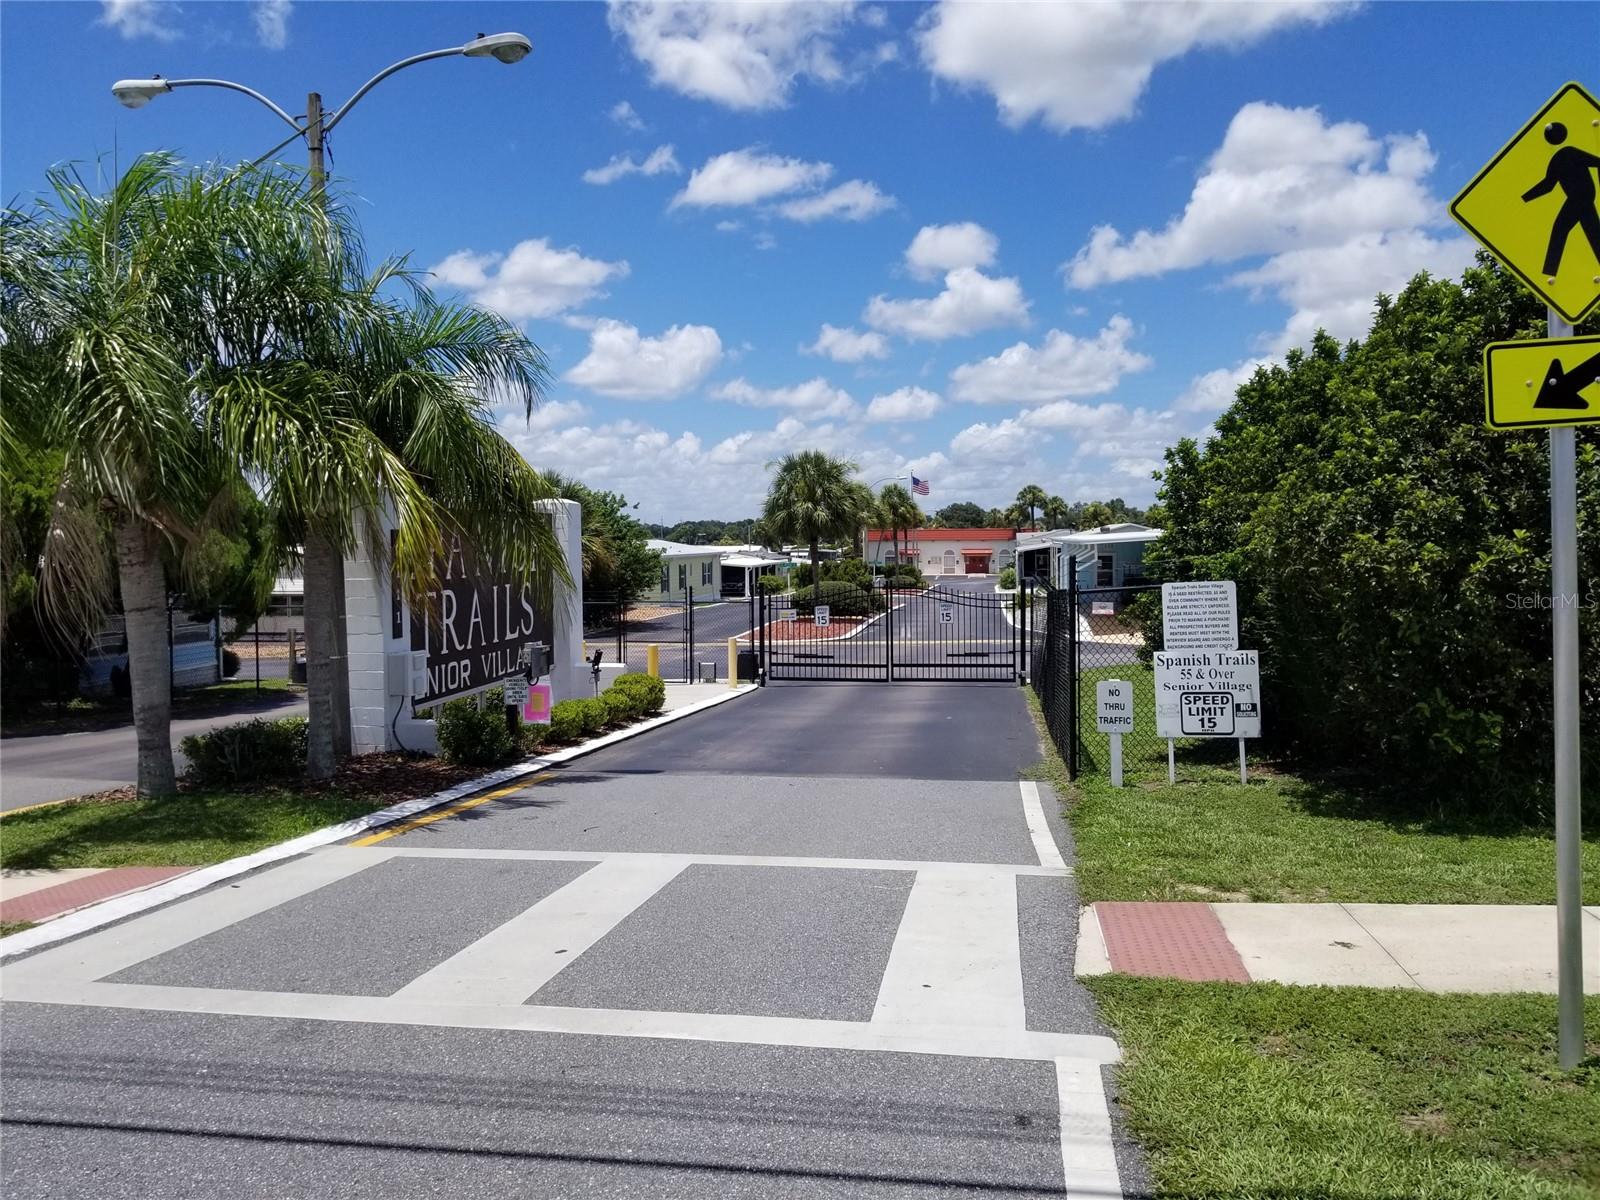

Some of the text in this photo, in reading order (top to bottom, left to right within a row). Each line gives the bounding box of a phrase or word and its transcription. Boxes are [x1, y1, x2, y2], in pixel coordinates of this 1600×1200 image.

[817, 616, 827, 625] 15
[941, 612, 951, 621] 15
[1157, 653, 1255, 670] Spanish Trails
[426, 645, 531, 697] NIOR VILLA
[1180, 668, 1235, 679] 55 & Over
[1163, 681, 1252, 692] Senior Village
[1184, 695, 1230, 705] SPEED
[1188, 707, 1226, 716] LIMIT
[1098, 717, 1131, 725] TRAFFIC
[1198, 717, 1217, 729] 15
